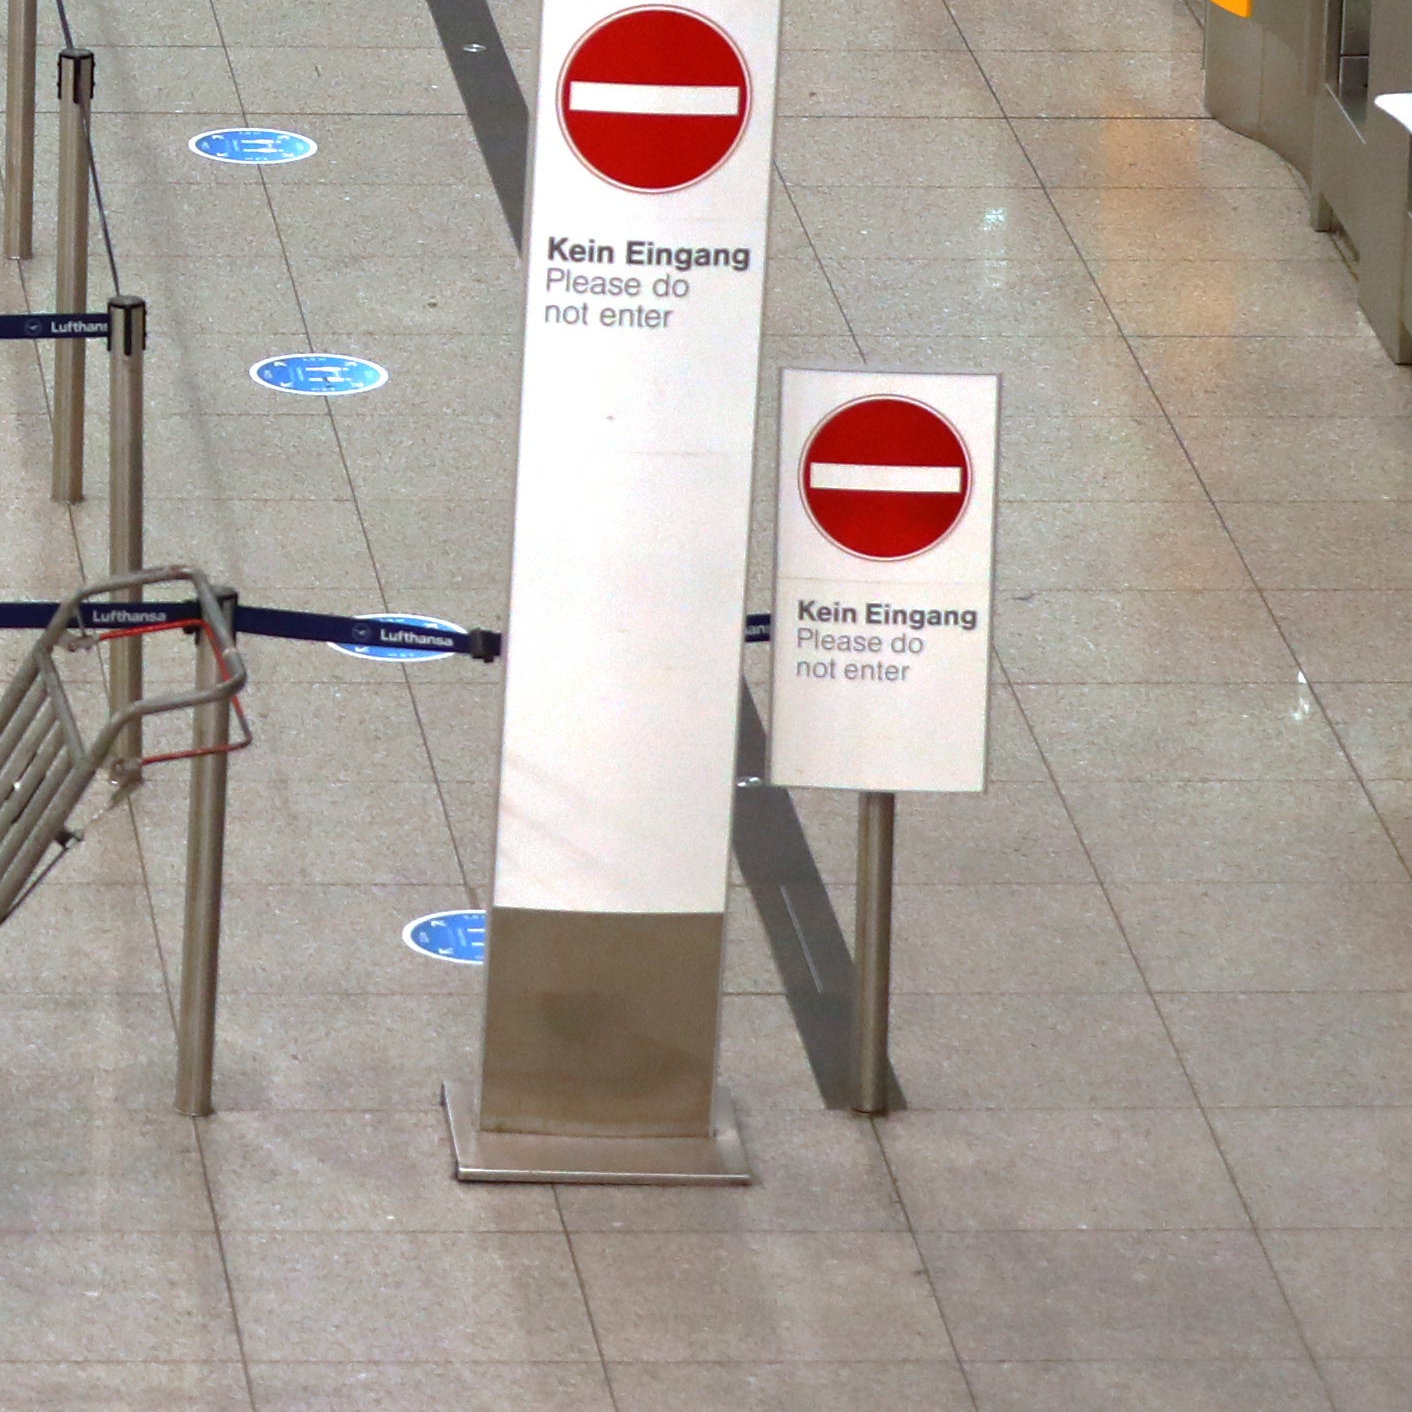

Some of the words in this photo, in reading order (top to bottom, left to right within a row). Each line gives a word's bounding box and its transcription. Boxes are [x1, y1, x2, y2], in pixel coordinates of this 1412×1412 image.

[548, 236, 614, 264] Kein
[626, 240, 751, 271] Eingang
[546, 267, 641, 297] Please
[653, 273, 690, 298] do
[544, 302, 589, 325] not
[599, 304, 674, 328] enter
[93, 609, 167, 623] Lufthansa
[797, 599, 857, 623] Kein
[866, 602, 977, 630] Eingang
[380, 629, 454, 648] Lufthansa
[796, 627, 882, 653] Please
[891, 632, 924, 654] do
[796, 658, 836, 679] not
[844, 660, 910, 681] enter
